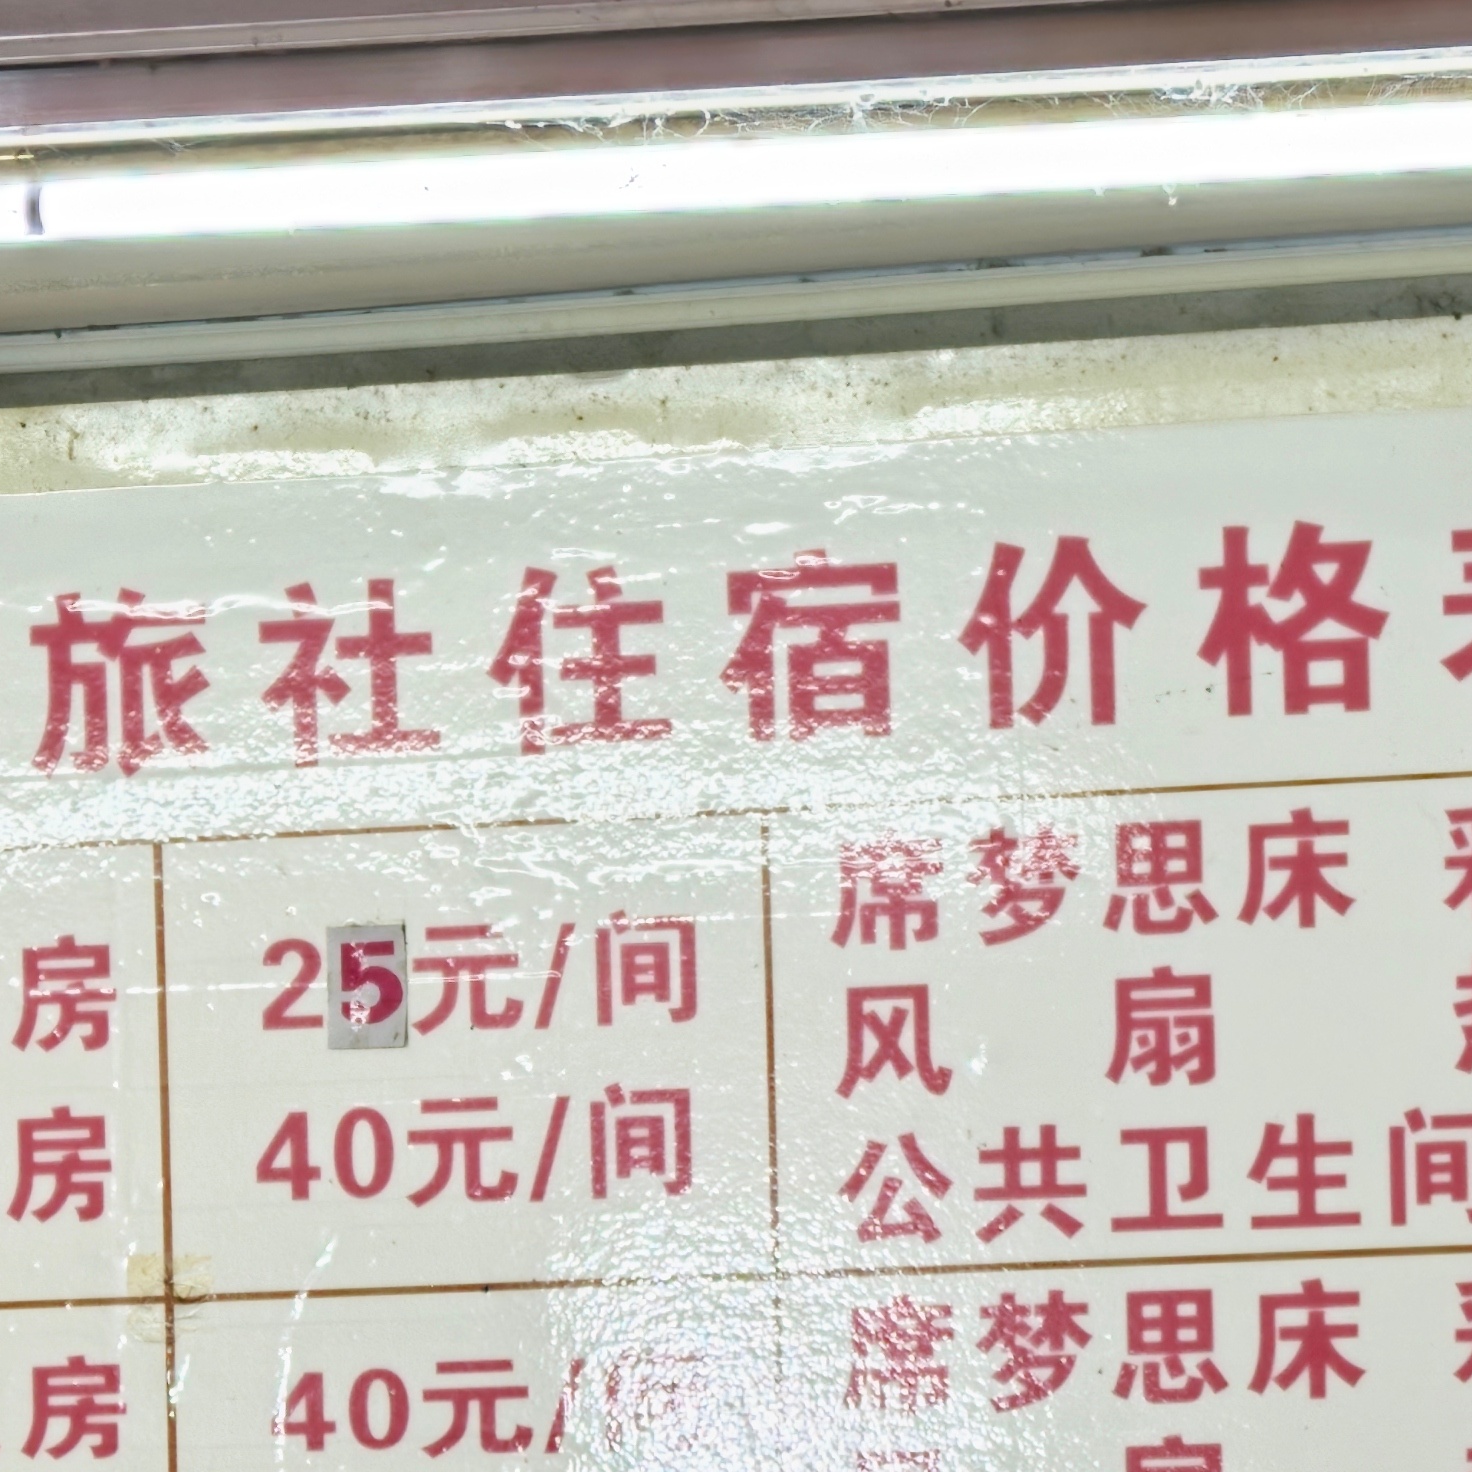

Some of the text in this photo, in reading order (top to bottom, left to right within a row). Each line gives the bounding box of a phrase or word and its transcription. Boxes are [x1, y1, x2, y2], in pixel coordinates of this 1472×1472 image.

[831, 806, 1356, 953] 席梦思床
[260, 909, 699, 1036] 25元/间
[255, 1081, 694, 1207] 40元/间
[269, 1346, 705, 1459] 40元/间
[842, 1278, 1366, 1416] 席梦思床
